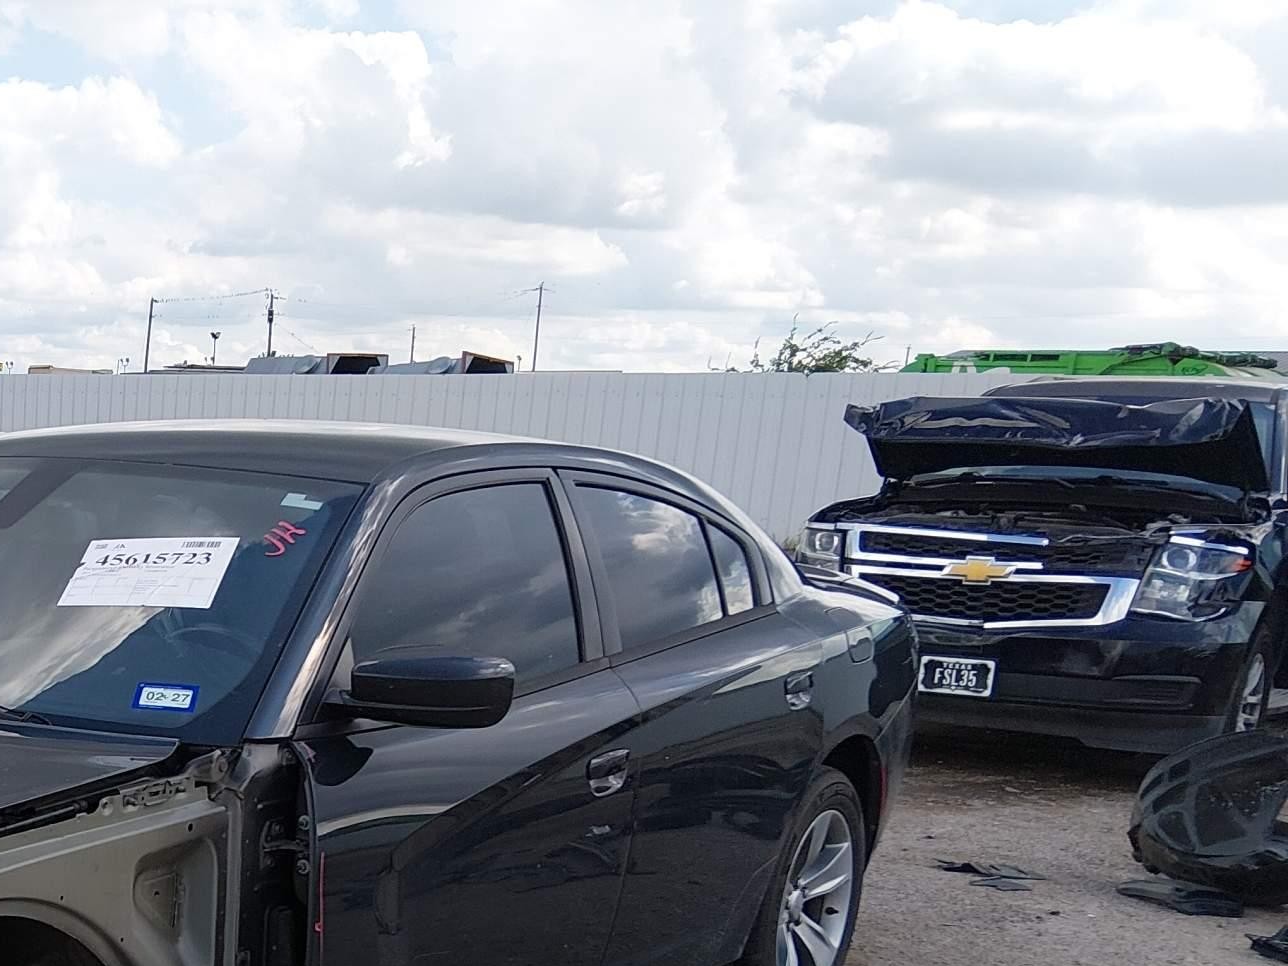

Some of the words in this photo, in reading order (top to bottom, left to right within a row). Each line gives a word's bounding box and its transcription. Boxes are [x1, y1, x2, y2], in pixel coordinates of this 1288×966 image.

[95, 552, 212, 567] 45615723
[943, 662, 972, 670] TEXAS
[933, 668, 978, 687] FSL35
